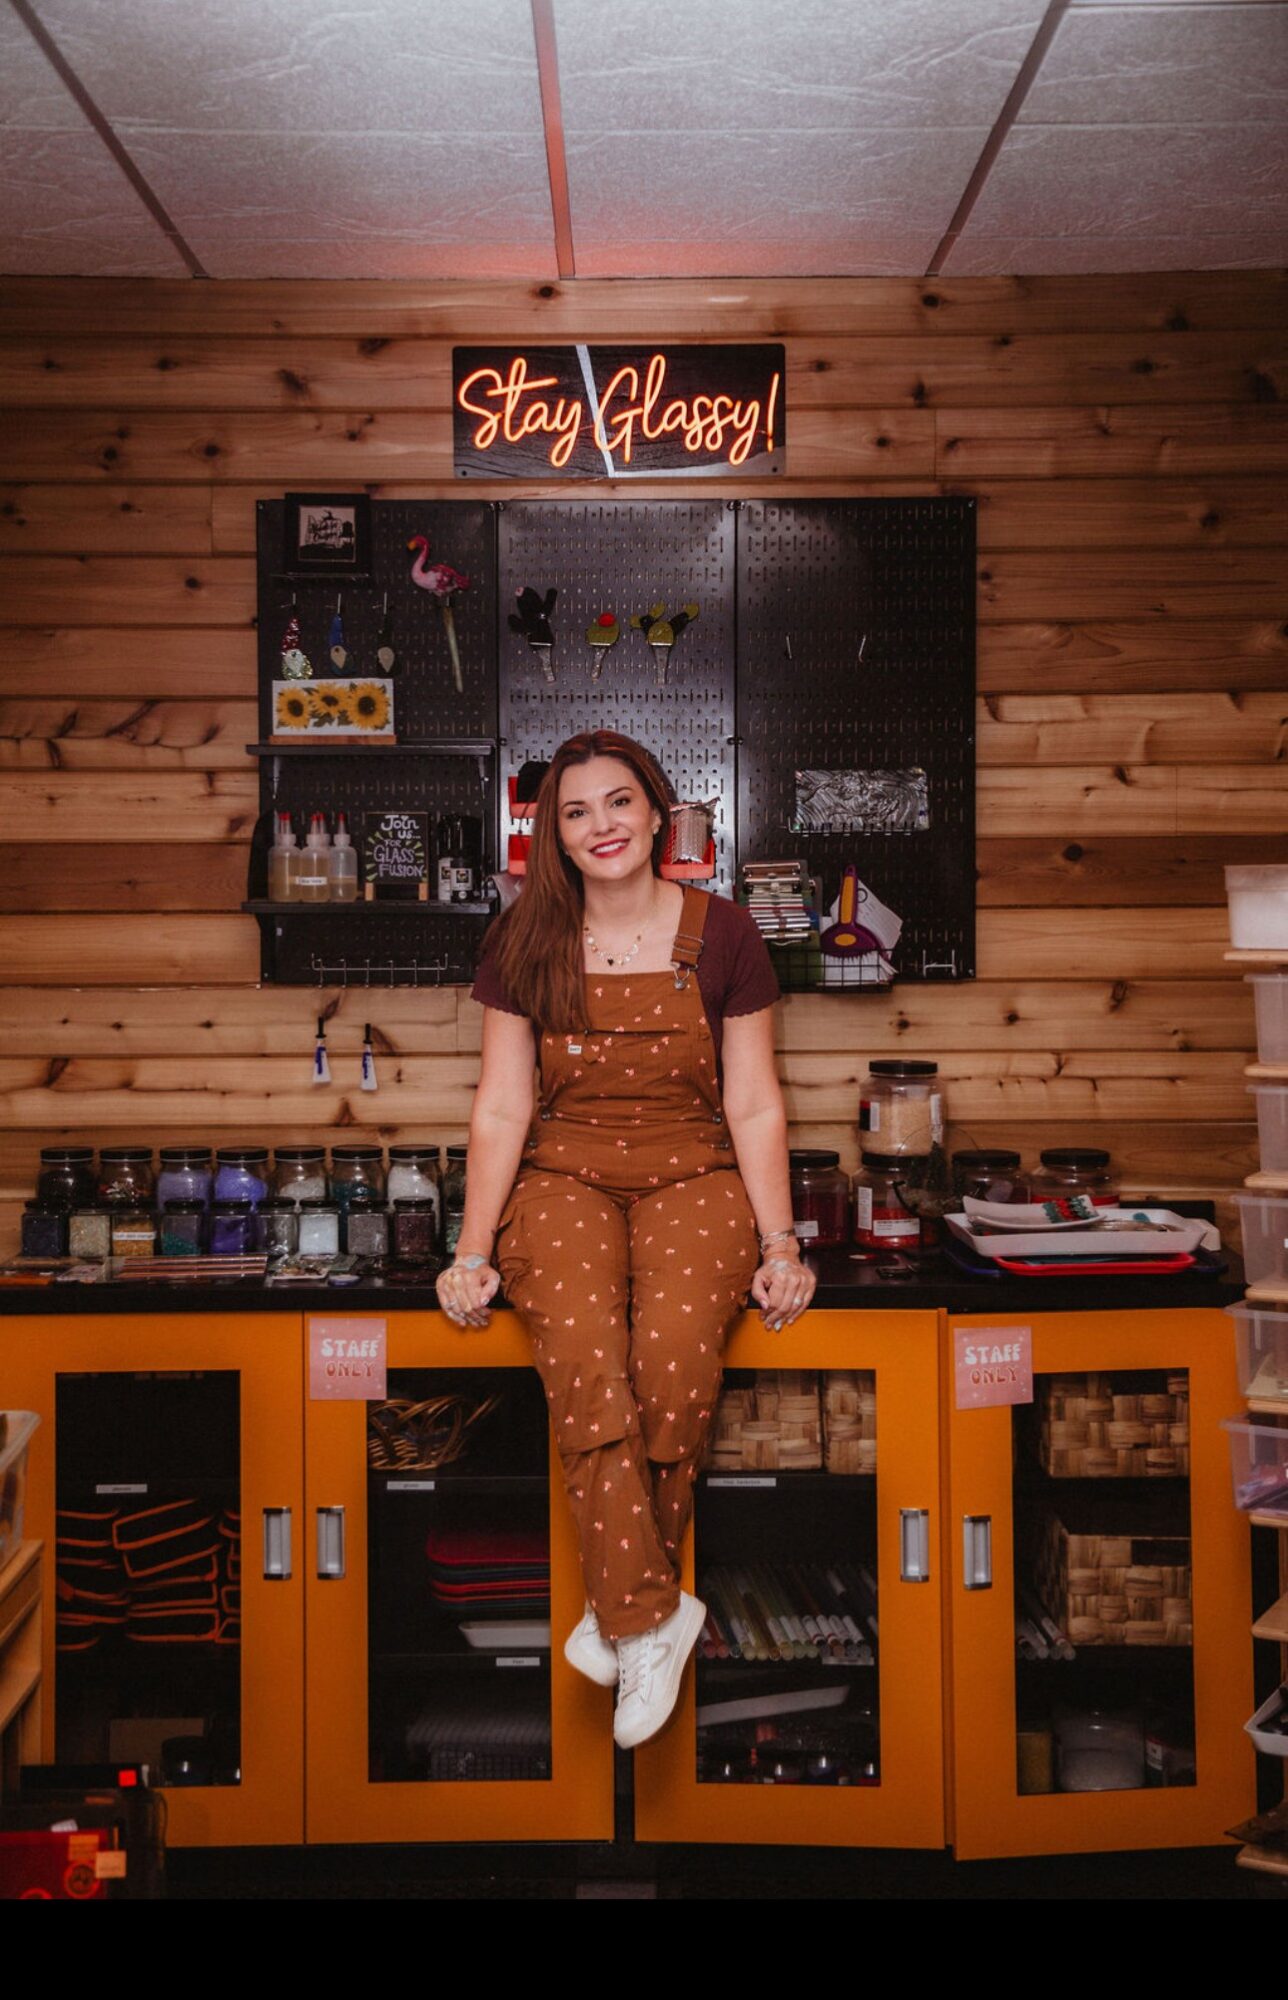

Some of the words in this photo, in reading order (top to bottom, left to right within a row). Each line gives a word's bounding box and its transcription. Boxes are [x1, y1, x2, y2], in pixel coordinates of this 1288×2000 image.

[457, 356, 582, 468] Stay
[593, 353, 780, 467] Glassy!
[381, 815, 419, 831] Join
[384, 839, 402, 848] FOR
[374, 845, 414, 864] GLASS
[379, 864, 424, 877] FUSION
[321, 1338, 379, 1358] STAFF
[964, 1343, 1021, 1365] STAFF
[325, 1361, 376, 1377] ONLY
[970, 1366, 1018, 1385] ONLY
